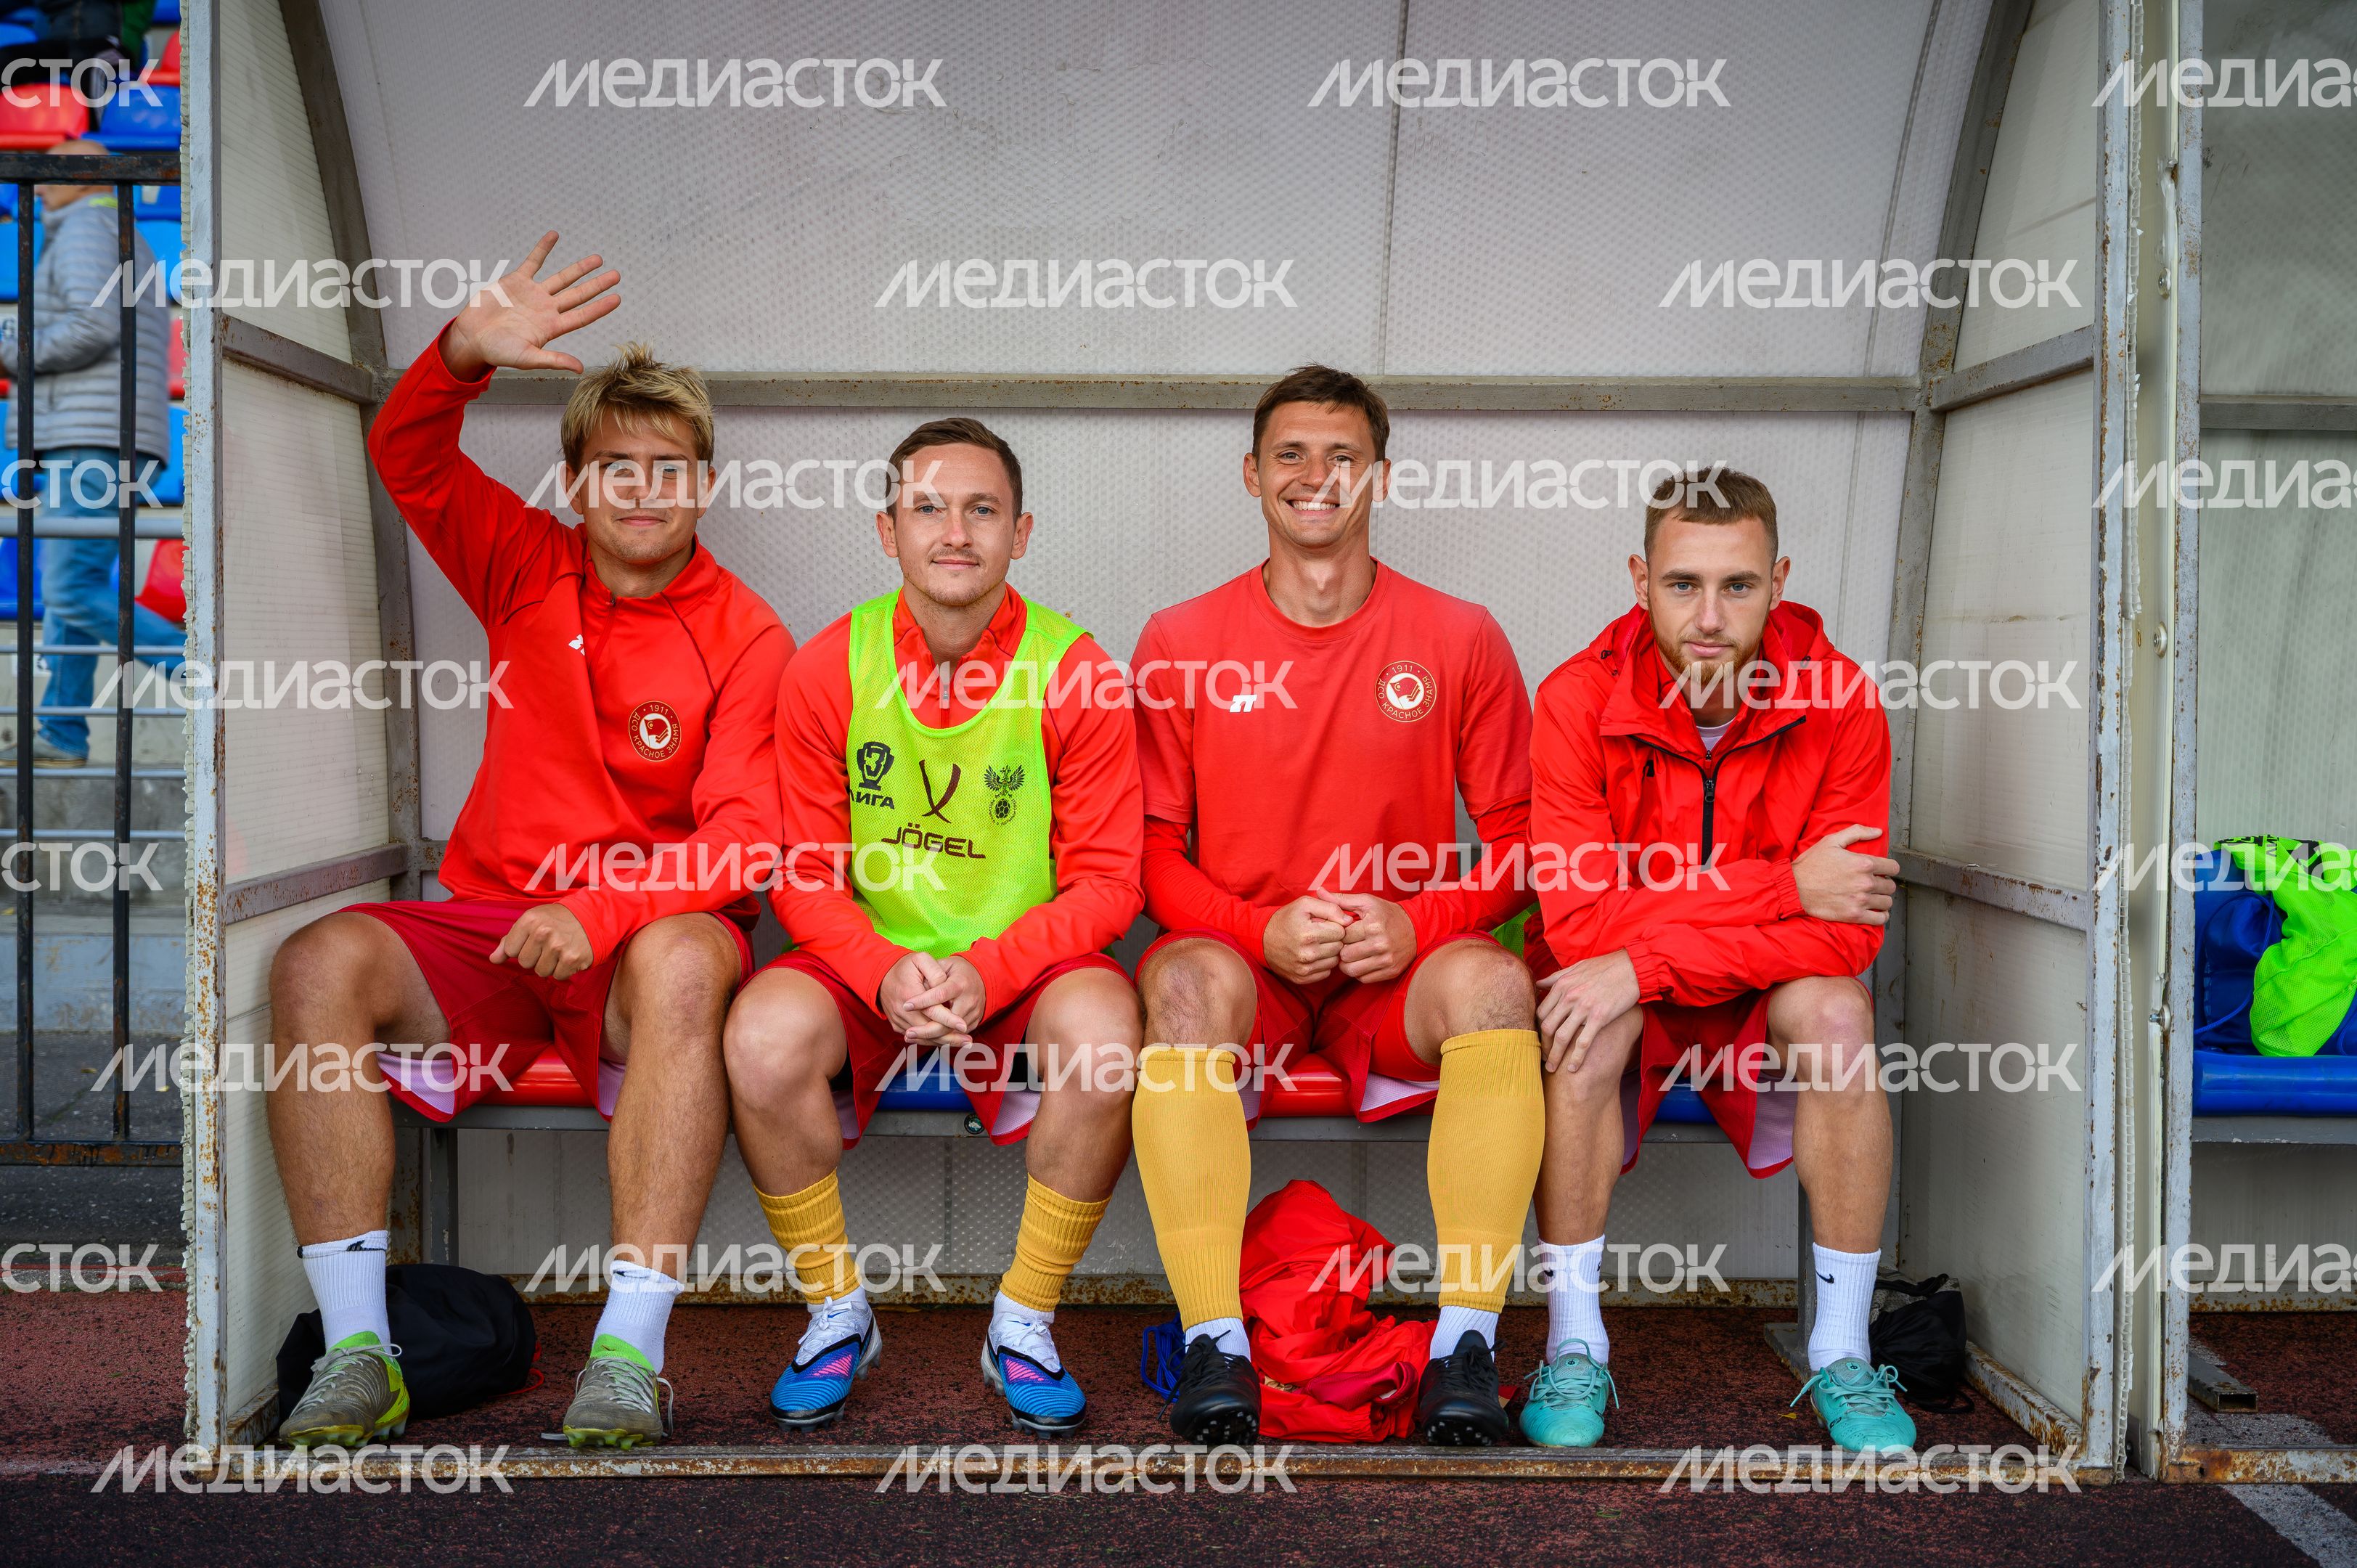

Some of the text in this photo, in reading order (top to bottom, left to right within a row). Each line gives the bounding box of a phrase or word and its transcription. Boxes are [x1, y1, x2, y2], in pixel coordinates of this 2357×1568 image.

[1392, 664, 1413, 674] 1911
[650, 704, 669, 715] 1911
[1377, 675, 1433, 719] ДСО КРАСНОЕ ЗНАМЯ
[631, 712, 679, 759] ДСО КРАСНОЕ ЗНАМЯ
[881, 822, 986, 859] JÖGEL
